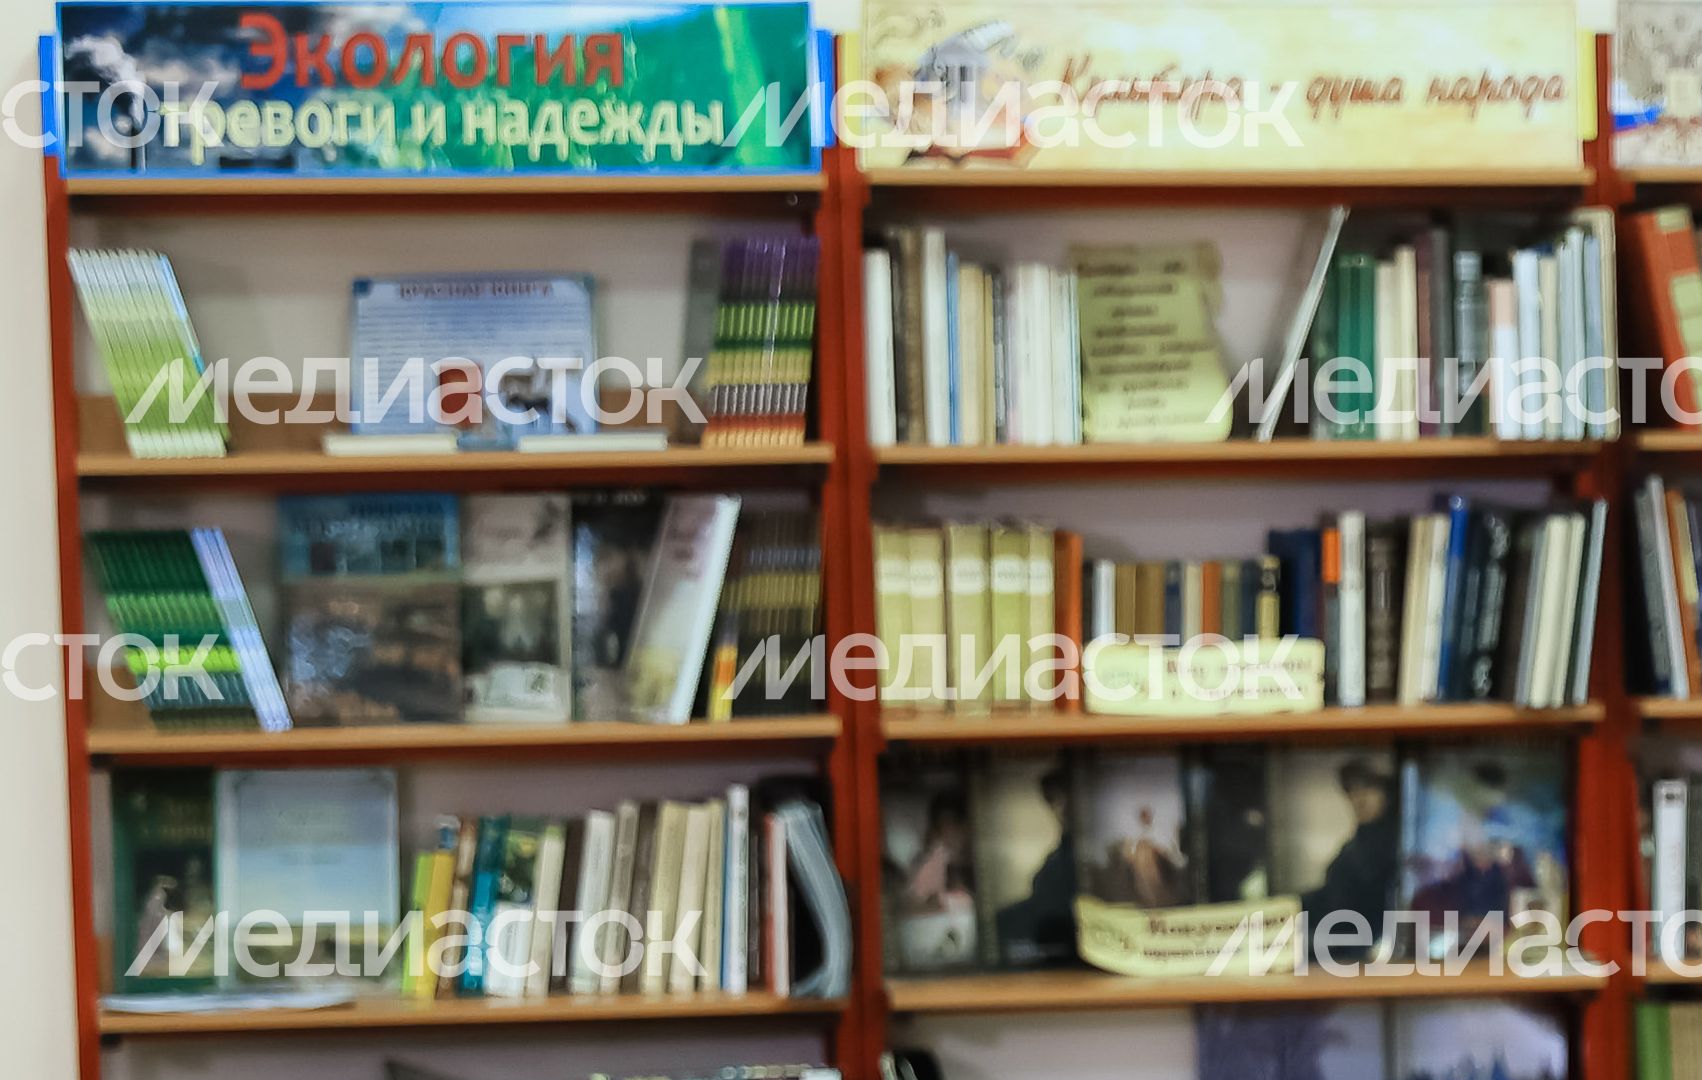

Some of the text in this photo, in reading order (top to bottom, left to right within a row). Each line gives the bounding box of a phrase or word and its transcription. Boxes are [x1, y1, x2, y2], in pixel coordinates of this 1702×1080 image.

[239, 13, 627, 91] Экология
[1306, 73, 1404, 121] душа
[1426, 68, 1567, 121] народа
[408, 106, 448, 147] и
[463, 100, 726, 162] надежды
